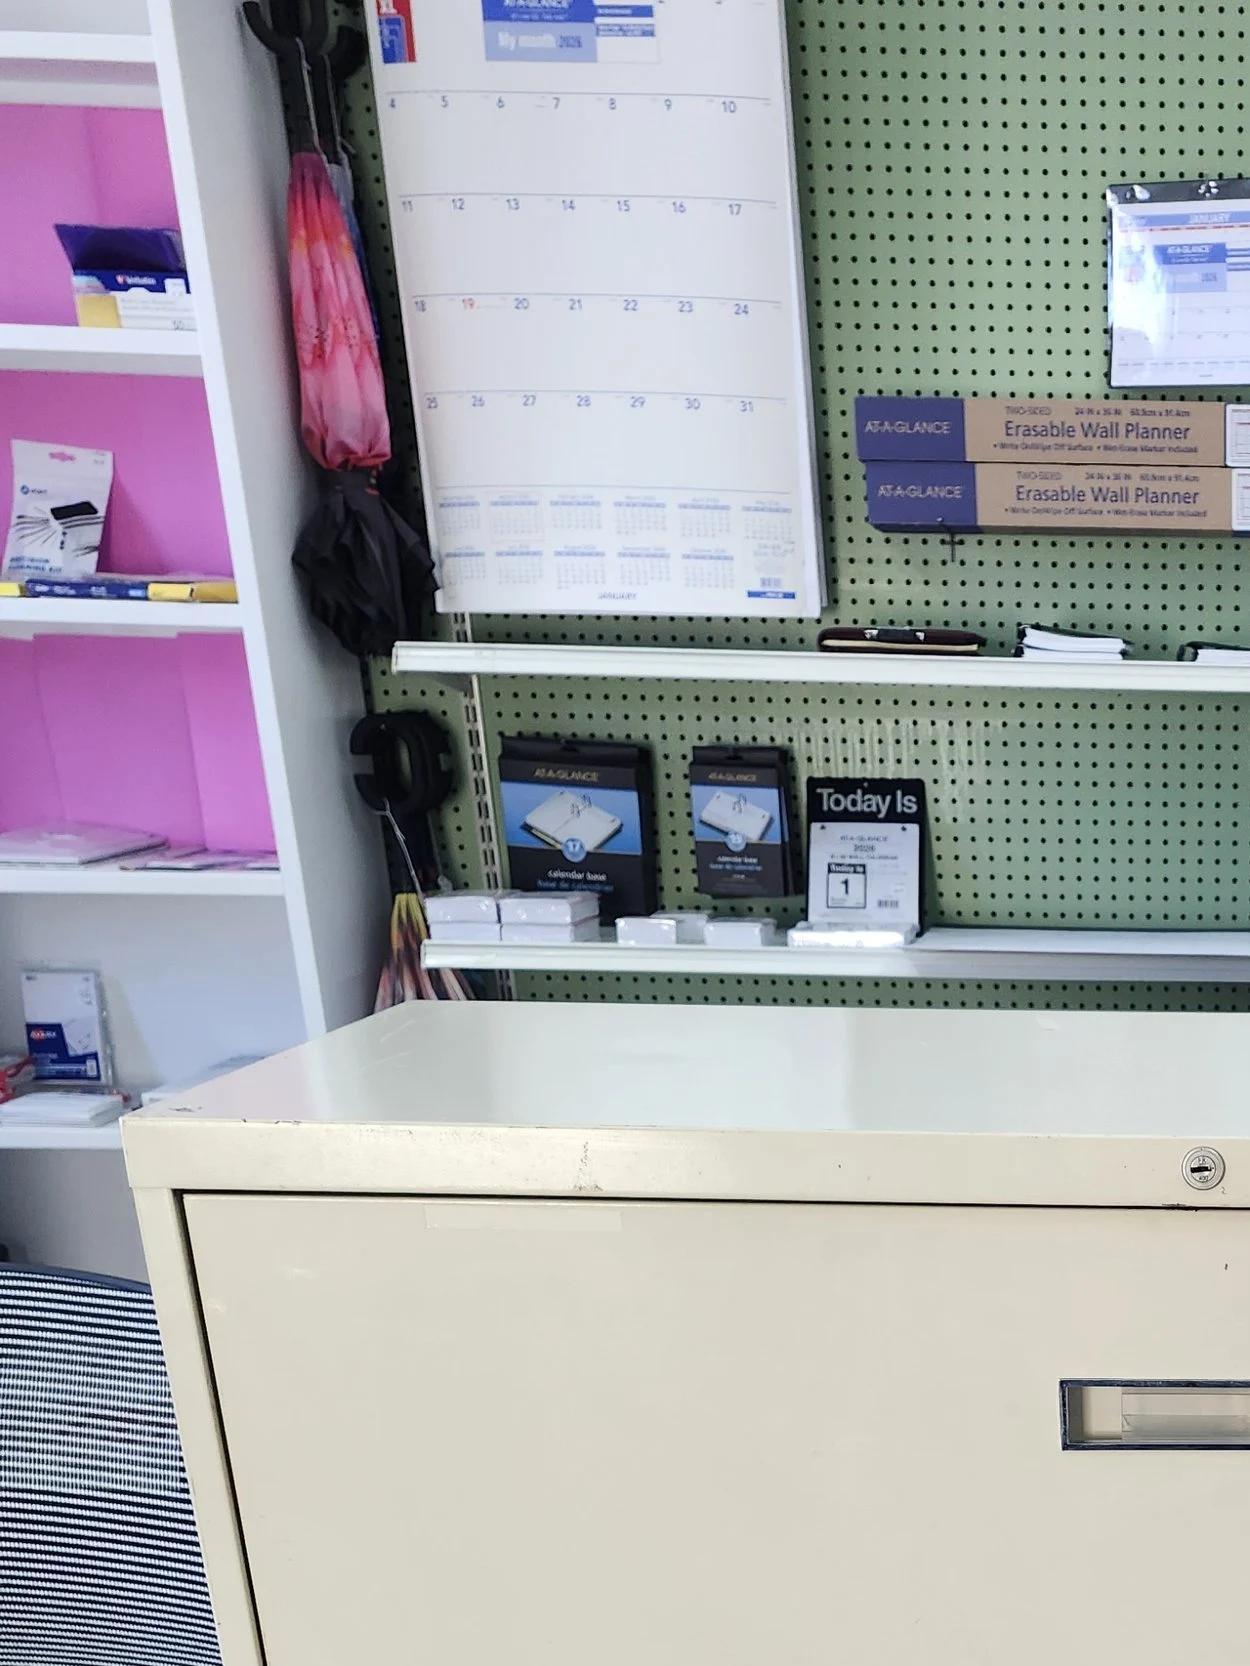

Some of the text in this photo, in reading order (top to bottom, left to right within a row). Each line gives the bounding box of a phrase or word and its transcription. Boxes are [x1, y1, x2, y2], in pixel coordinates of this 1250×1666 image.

[722, 101, 737, 114] 10
[451, 198, 465, 210] 12
[506, 199, 520, 211] 13
[561, 199, 576, 212] 14
[616, 200, 631, 212] 15
[671, 201, 686, 214] 16
[728, 203, 742, 216] 17
[514, 298, 529, 310] 20
[568, 299, 583, 311] 21
[623, 299, 638, 312] 22
[678, 300, 694, 313] 23
[734, 303, 749, 316] 24
[522, 394, 536, 406] 27
[577, 395, 591, 407] 28
[630, 395, 645, 407] 29
[685, 396, 700, 409] 30
[740, 400, 754, 413] 31
[865, 420, 951, 434] AT-A-GLANCE
[1005, 420, 1191, 440] Erasable Wall Planner
[877, 485, 963, 498] AT-A-GLANCE
[1016, 485, 1200, 505] Erasable Wall Planner
[815, 788, 918, 819] Today Is
[840, 878, 849, 895] 1
